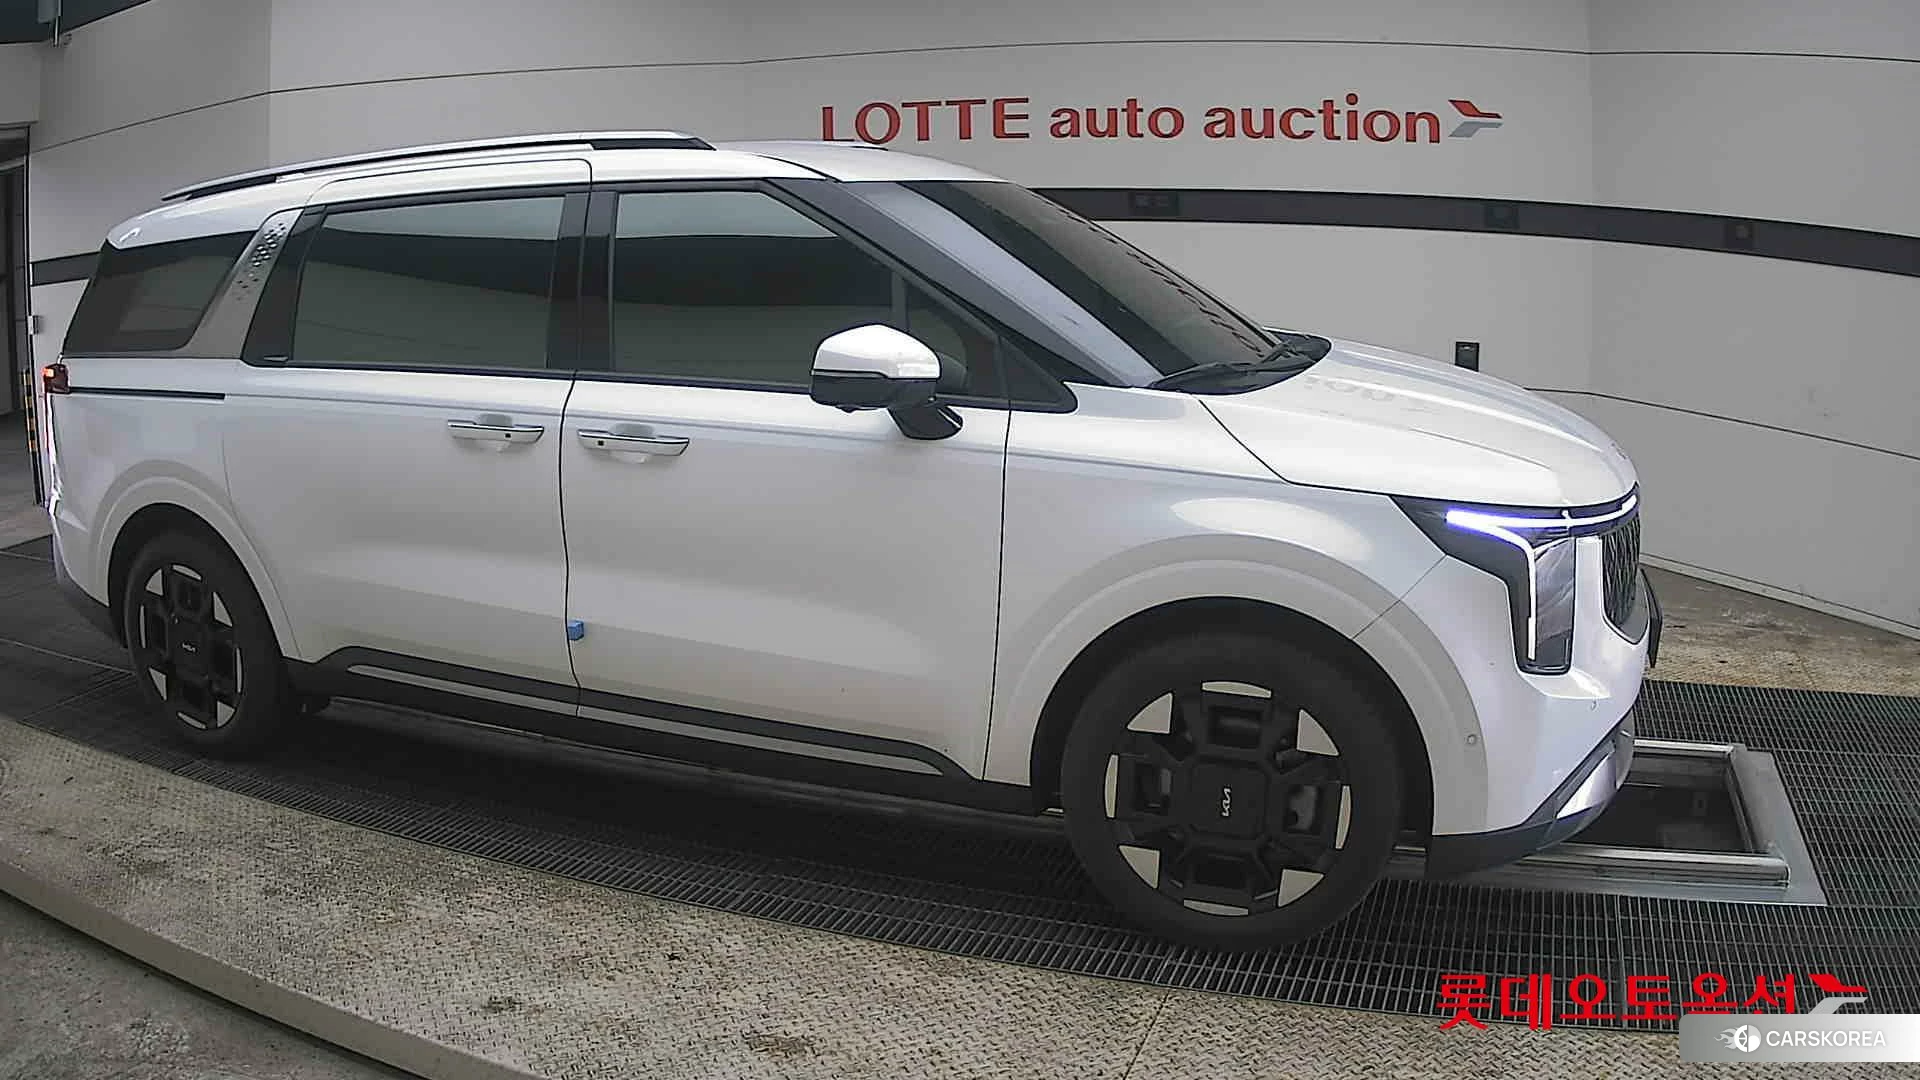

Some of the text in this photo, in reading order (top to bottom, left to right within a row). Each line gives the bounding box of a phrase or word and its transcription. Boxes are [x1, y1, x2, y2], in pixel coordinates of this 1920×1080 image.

[821, 93, 1441, 144] LOTTE auto auction
